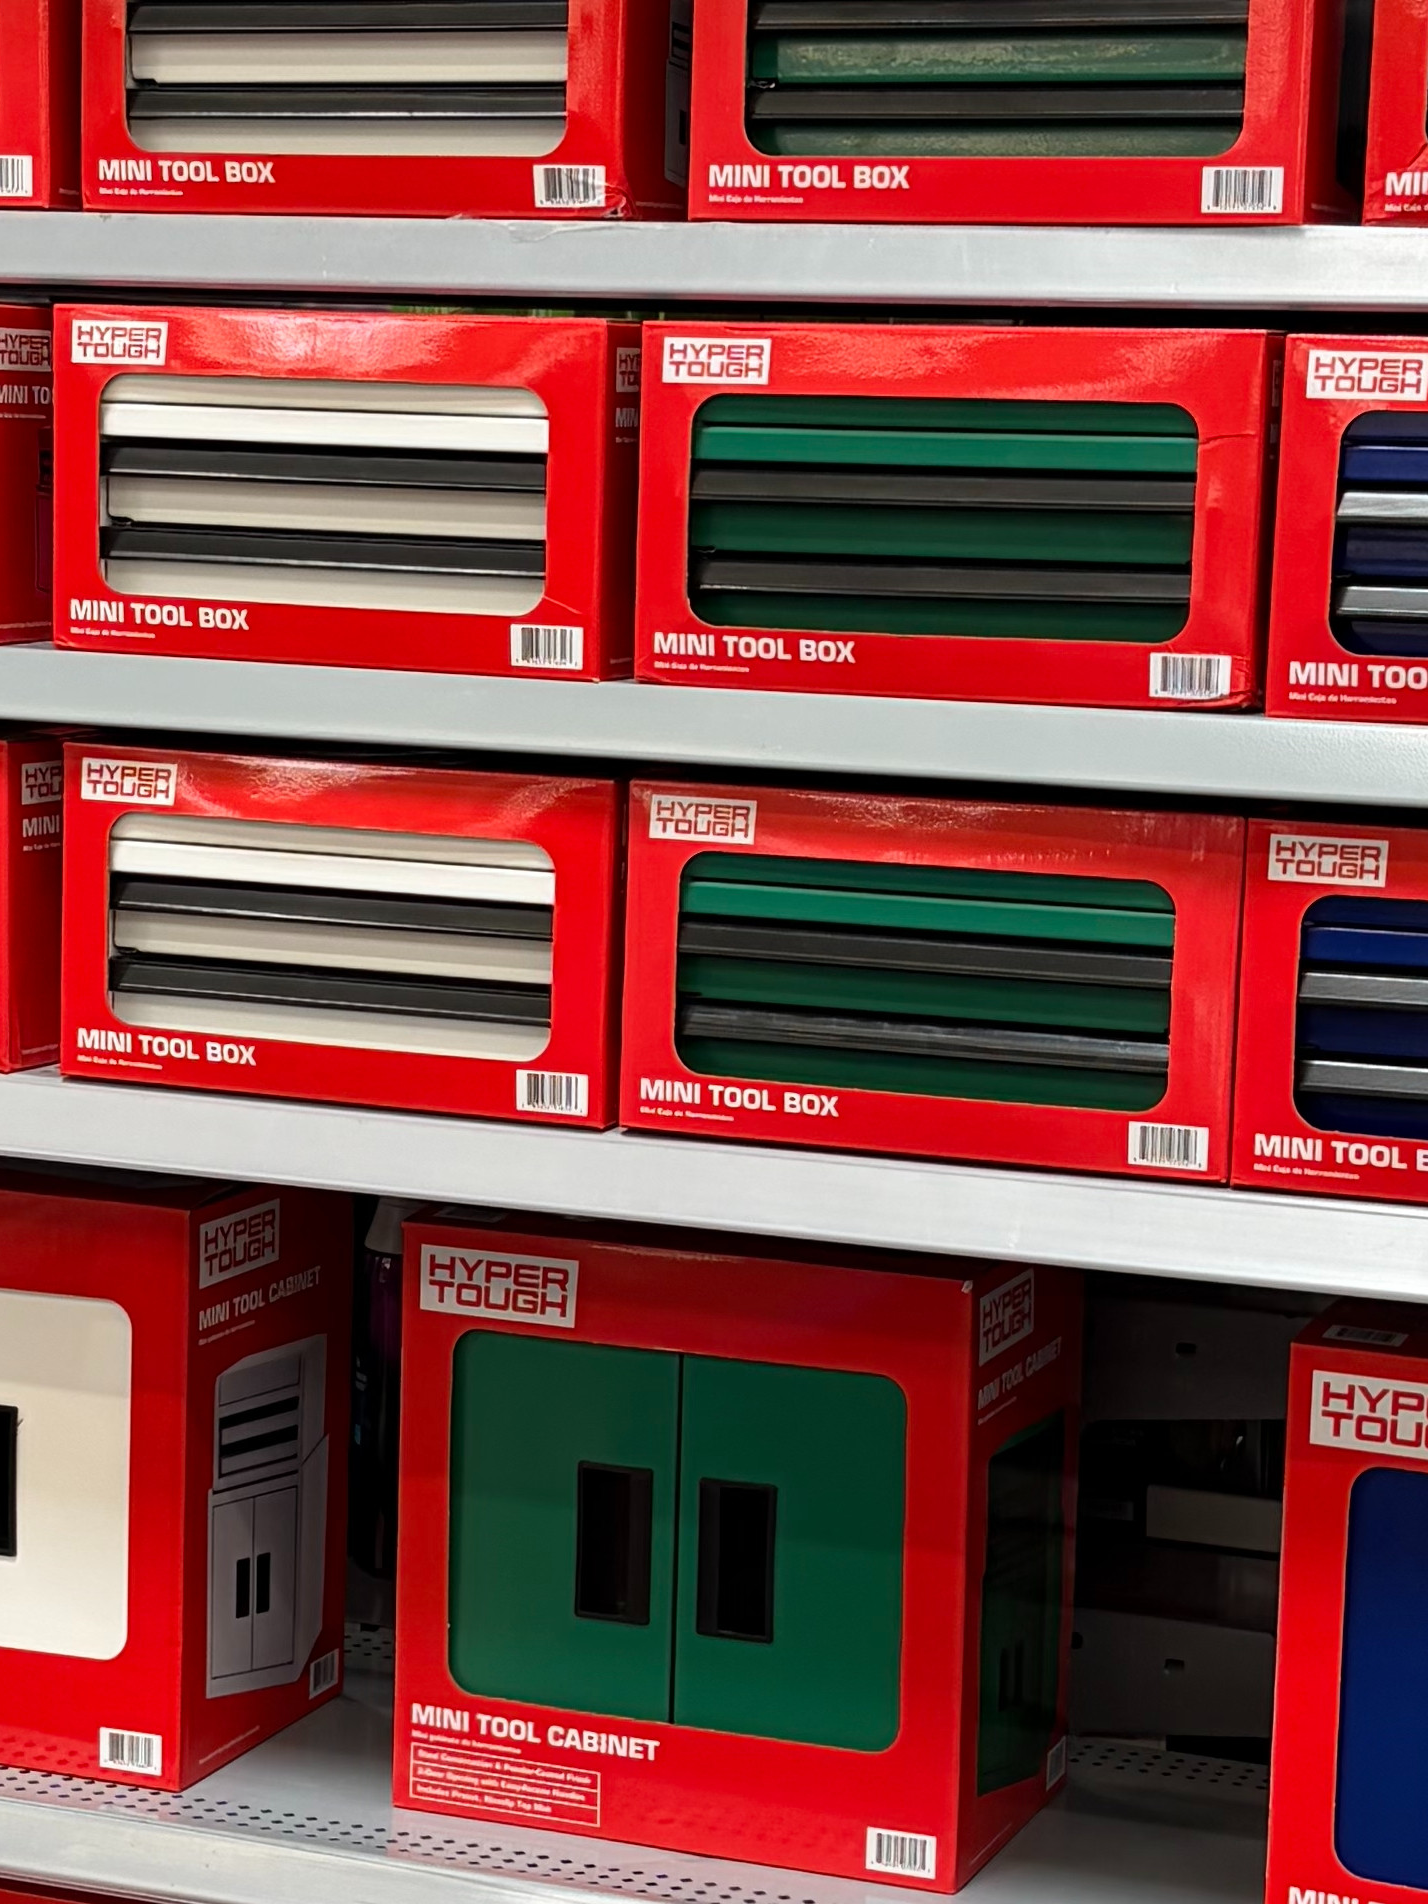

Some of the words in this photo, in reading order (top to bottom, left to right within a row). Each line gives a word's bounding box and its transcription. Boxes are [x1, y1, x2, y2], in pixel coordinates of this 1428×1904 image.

[709, 165, 770, 188] MINI
[778, 165, 846, 188] TOOL
[854, 165, 909, 189] BOX
[1314, 355, 1425, 377] HYPER
[1313, 373, 1423, 395] TOUGH
[1289, 661, 1358, 688] MINI
[88, 762, 172, 785] HYPER
[87, 778, 171, 801] TOUGH
[78, 1028, 132, 1053] MINI
[138, 1034, 199, 1060] TOOL
[206, 1041, 256, 1066] BOX
[428, 1252, 572, 1296] HYPER
[427, 1278, 571, 1320] TOUGH
[412, 1703, 469, 1732] MINI
[476, 1713, 541, 1744] TOOL
[548, 1725, 660, 1761] CABINET
